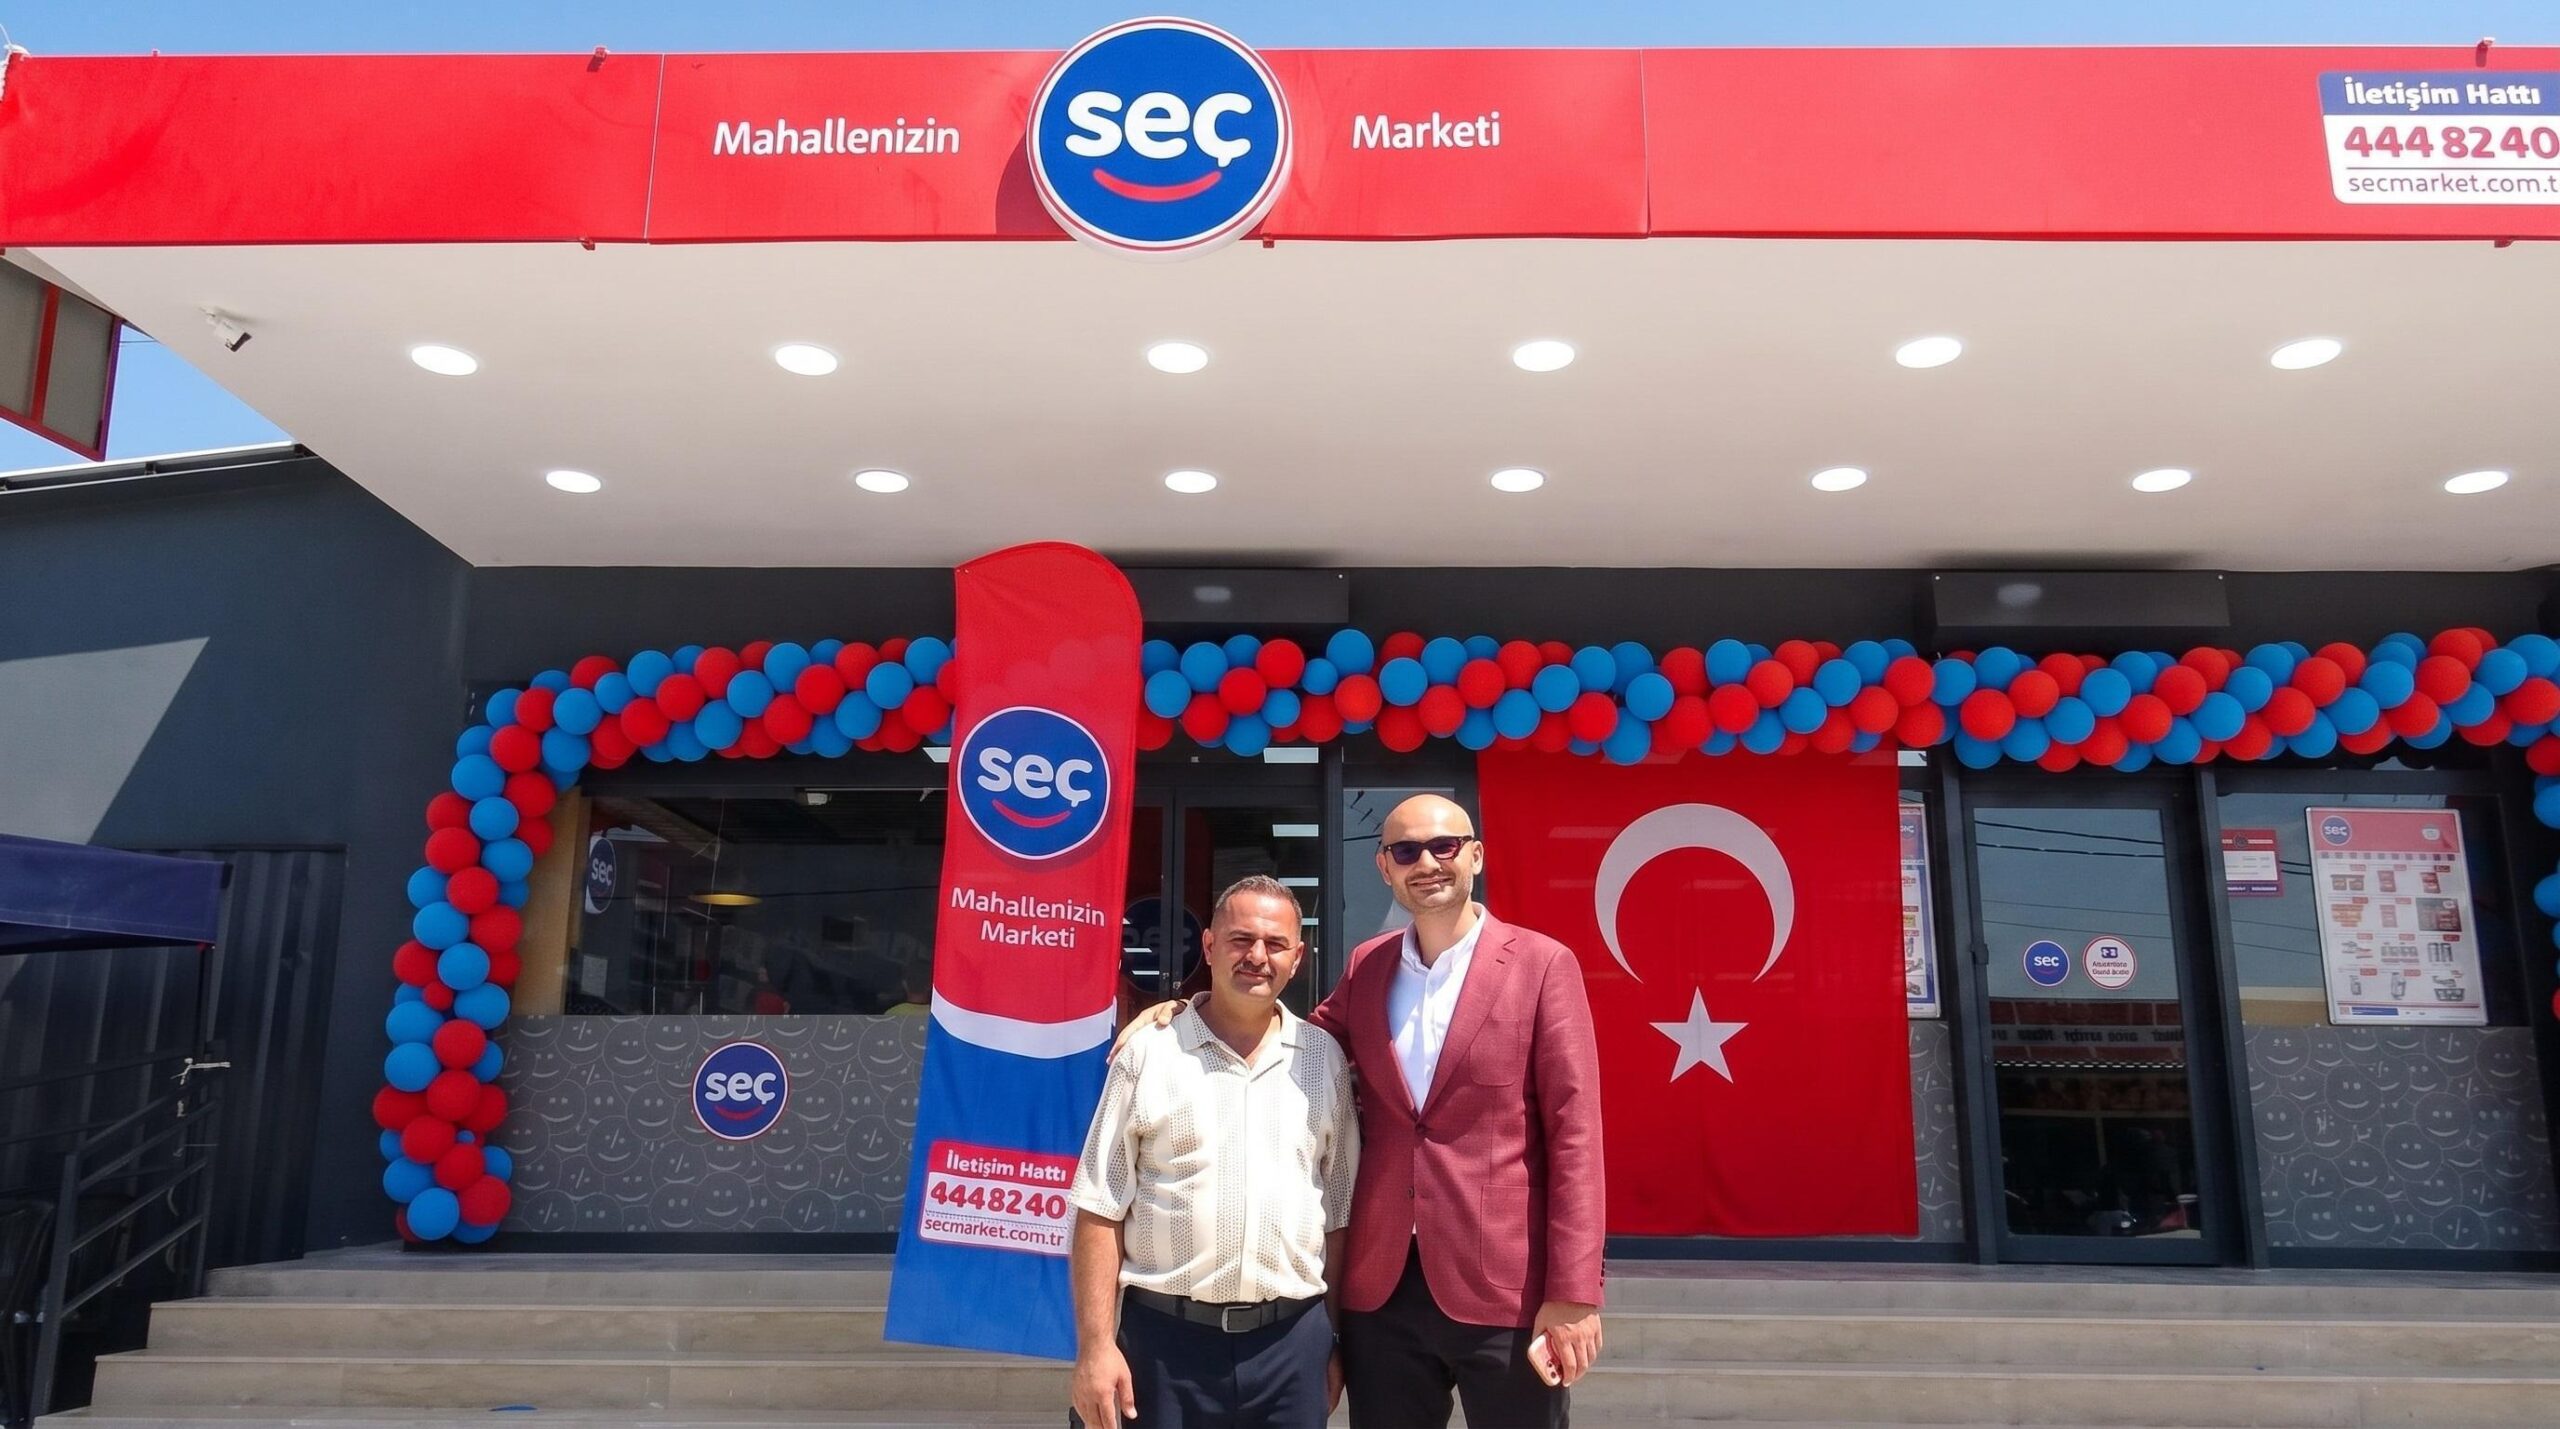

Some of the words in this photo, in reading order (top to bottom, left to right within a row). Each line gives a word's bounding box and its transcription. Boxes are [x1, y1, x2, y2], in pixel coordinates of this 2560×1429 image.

[2344, 76, 2459, 111] İletişim
[2466, 83, 2542, 105] Hattı
[714, 118, 960, 156] Mahallenizin
[1065, 90, 1252, 167] seç
[1352, 111, 1501, 150] Marketi
[2349, 173, 2558, 193] secmarket.com.t
[977, 747, 1094, 808] seç
[951, 887, 1106, 928] Mahallenizin
[980, 921, 1076, 949] Marketi
[704, 1070, 777, 1105] seç
[946, 1150, 1015, 1178] İletişim
[1019, 1161, 1067, 1183] Hattı
[924, 1218, 1065, 1247] secmarket.com.tr
